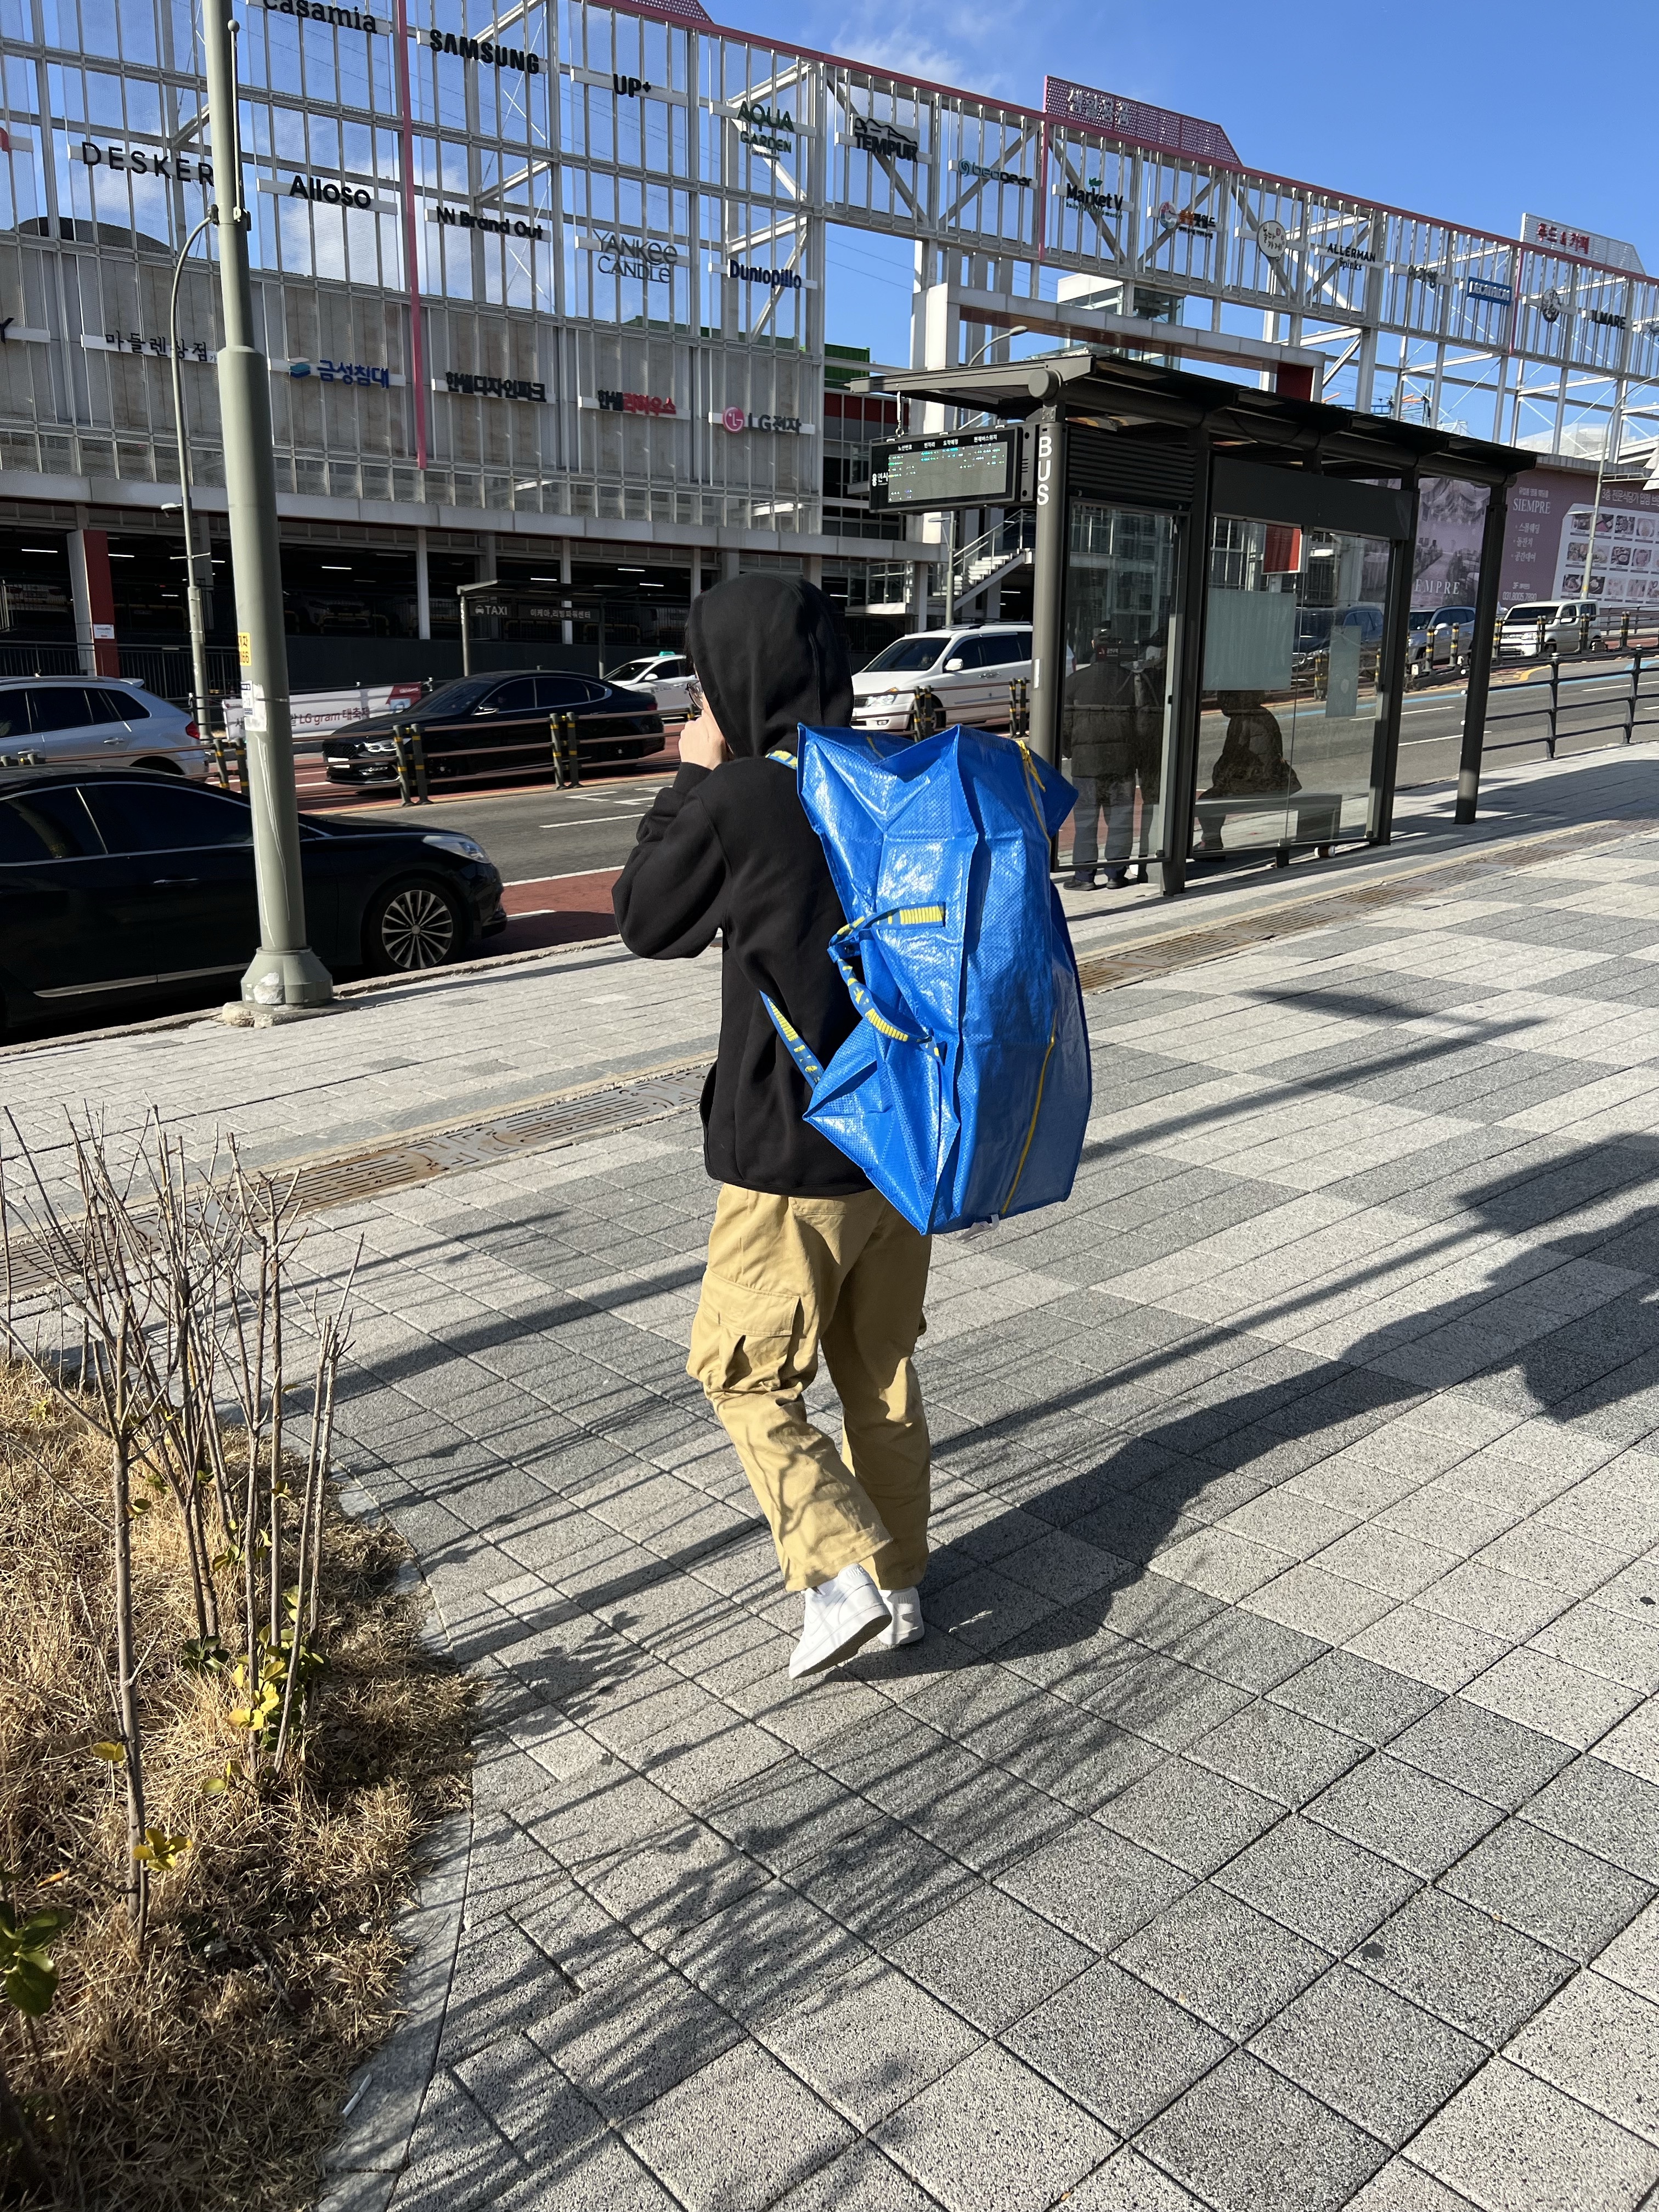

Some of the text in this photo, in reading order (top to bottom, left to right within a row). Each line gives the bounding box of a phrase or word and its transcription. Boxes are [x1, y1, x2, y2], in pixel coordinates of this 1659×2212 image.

[430, 29, 539, 74] SAMSUNG
[737, 100, 794, 132] AQUA
[1067, 88, 1130, 127] 생활용품
[740, 131, 792, 154] GARDEN
[854, 132, 918, 162] TEMPUR
[82, 141, 215, 187] DESKER
[290, 175, 371, 208] Alloso
[1066, 183, 1113, 208] Market
[1114, 194, 1124, 211] V
[460, 211, 510, 234] Brand
[514, 221, 543, 240] Out
[1327, 243, 1376, 262] ALLERMAN
[728, 259, 802, 290] Dunlopillo
[105, 330, 207, 362] 마들렌상점
[317, 359, 389, 388] 금성침대
[445, 371, 547, 403] 한샘디자인파크
[597, 390, 676, 416] 한샘리하우스
[1037, 436, 1052, 506] BUS
[1513, 498, 1550, 514] SIEMPRE
[485, 605, 507, 616] TAXI
[299, 714, 312, 725] LG
[314, 713, 341, 726] gram
